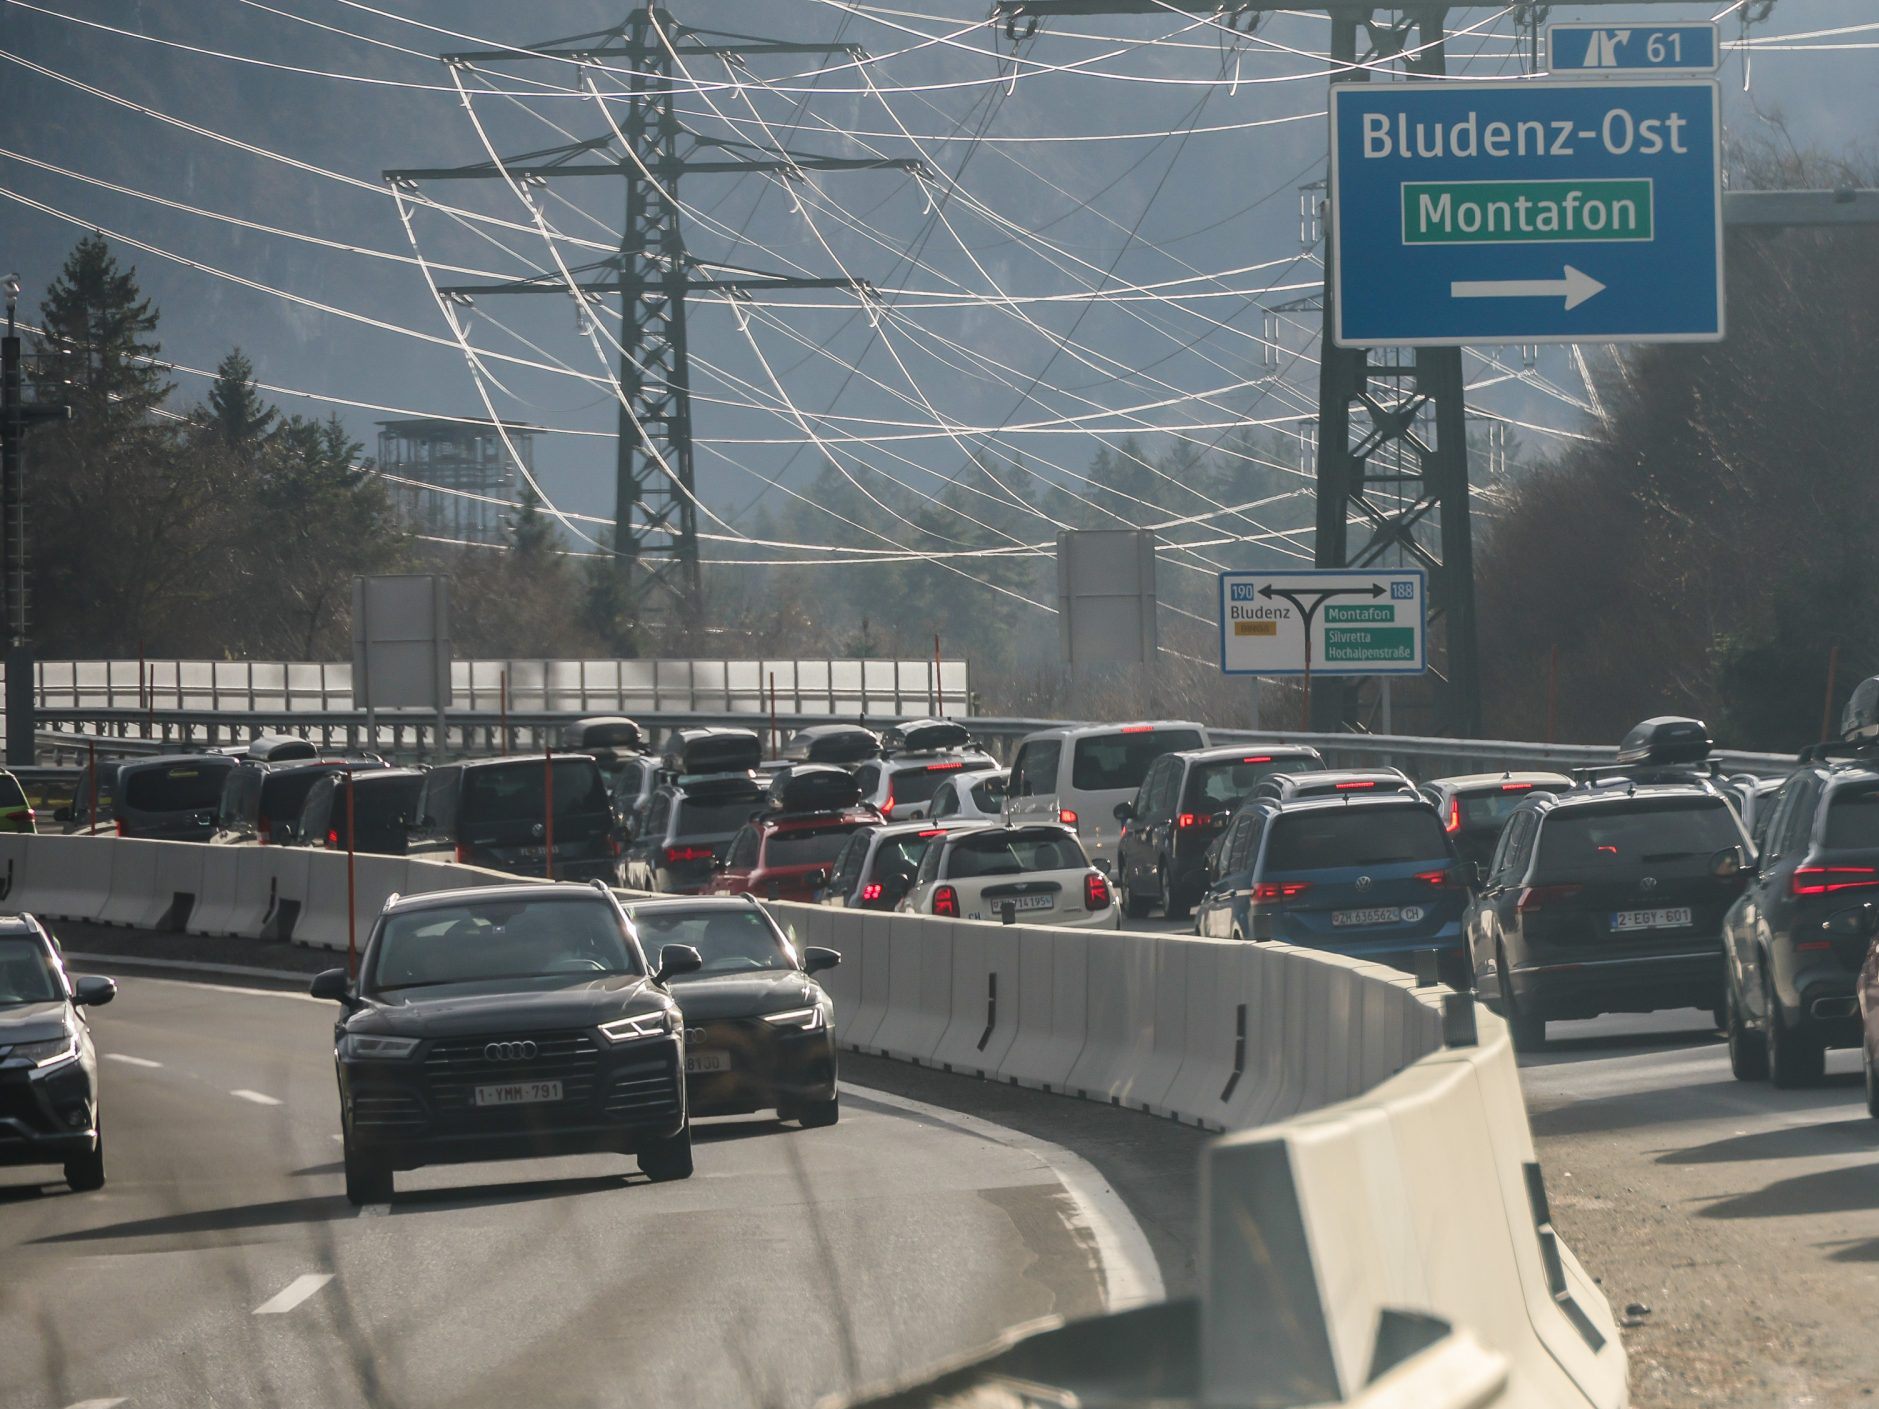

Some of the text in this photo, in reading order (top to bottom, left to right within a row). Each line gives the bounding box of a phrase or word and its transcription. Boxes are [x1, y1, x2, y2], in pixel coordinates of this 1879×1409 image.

[1646, 32, 1683, 62] 61
[1362, 108, 1688, 159] Bludenz-Ost
[1419, 191, 1636, 233] Montafon
[1232, 585, 1253, 599] 190
[1392, 583, 1413, 598] 188
[1231, 605, 1290, 619] Bludenz
[1329, 608, 1390, 620] Montafon
[1329, 631, 1371, 643] Silvretta
[1329, 646, 1411, 660] Hochalpenstraße
[1406, 909, 1419, 920] CH
